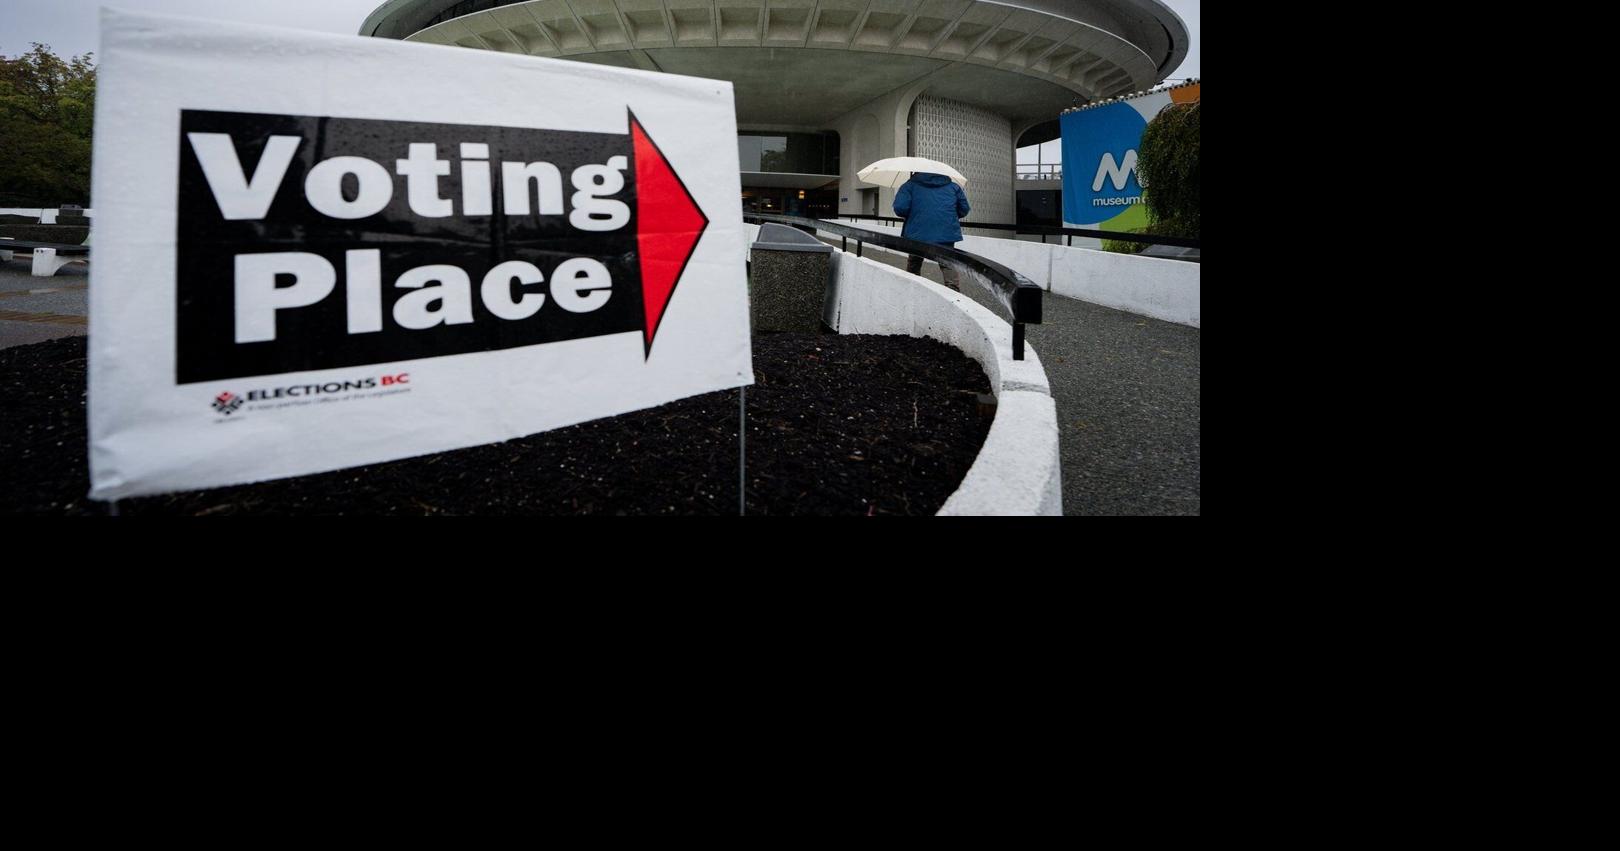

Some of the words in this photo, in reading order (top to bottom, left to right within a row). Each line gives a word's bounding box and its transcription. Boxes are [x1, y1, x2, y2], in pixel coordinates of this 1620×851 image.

[187, 132, 631, 232] Voting
[1093, 196, 1140, 207] museum
[234, 248, 612, 344] Place
[247, 378, 376, 401] ELECTIONS
[381, 373, 410, 387] BC
